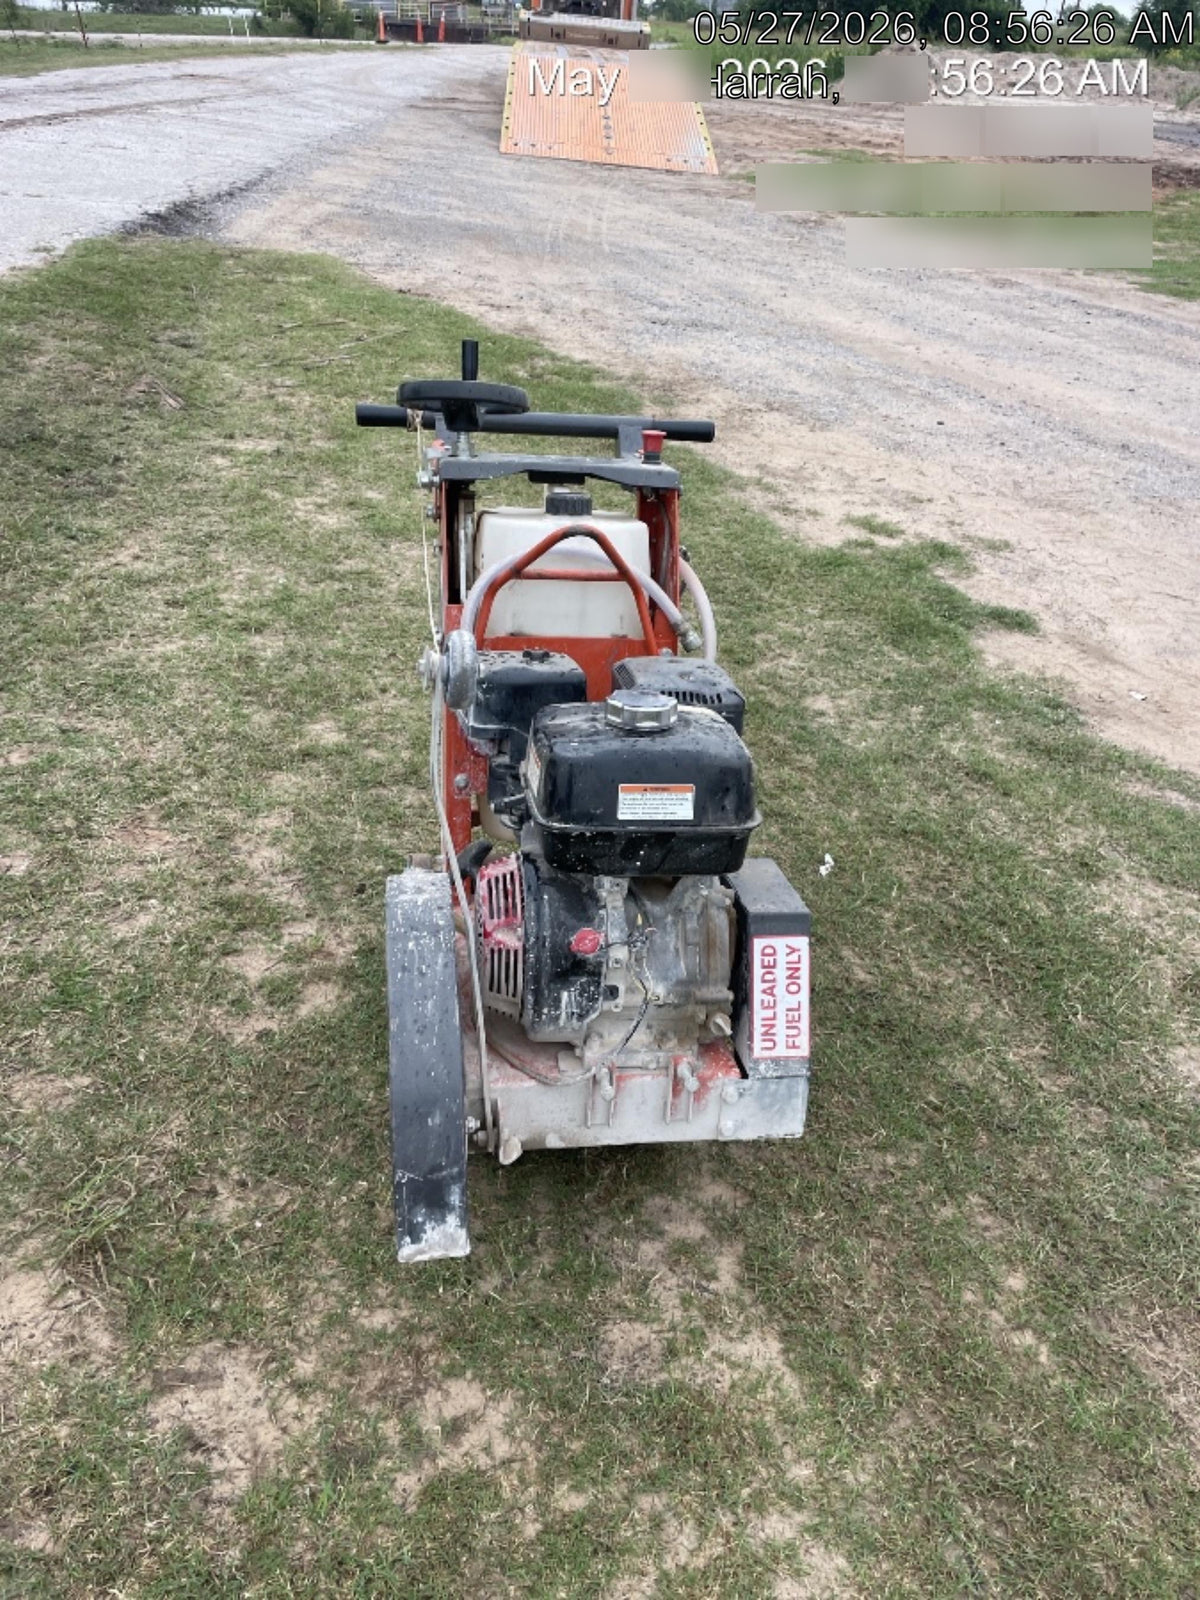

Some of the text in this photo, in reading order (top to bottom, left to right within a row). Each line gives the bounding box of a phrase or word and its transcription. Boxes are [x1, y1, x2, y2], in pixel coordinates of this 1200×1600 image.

[760, 944, 778, 1051] UNLEADED
[785, 943, 803, 1050] FUEL ONLY
